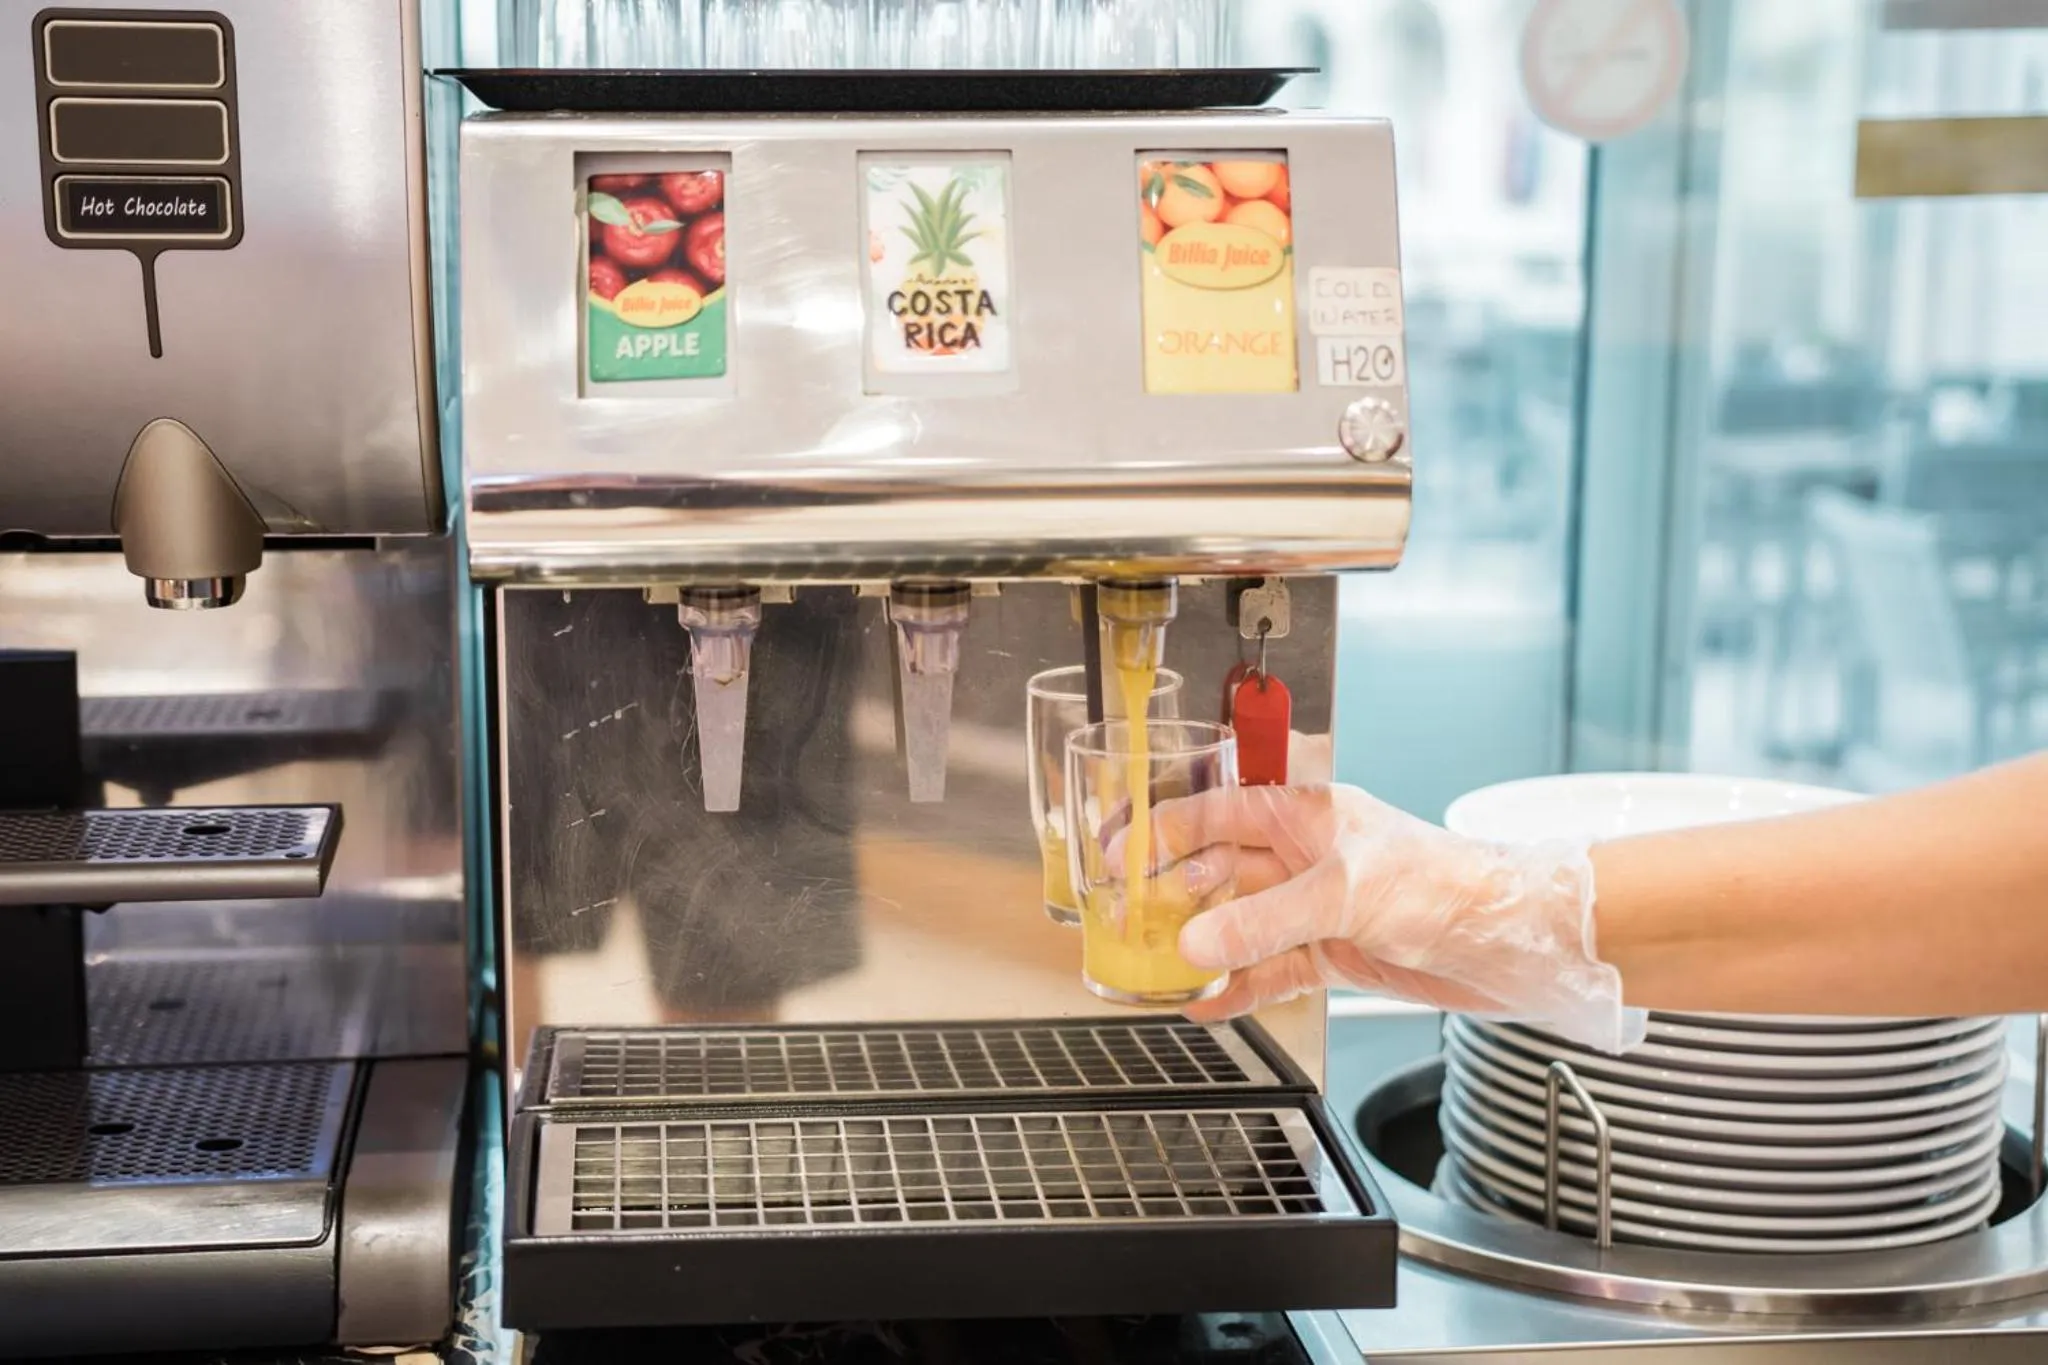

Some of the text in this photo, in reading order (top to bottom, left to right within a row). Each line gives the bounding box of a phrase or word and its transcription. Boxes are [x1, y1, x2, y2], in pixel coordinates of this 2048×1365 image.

[80, 196, 208, 216] Hot Chocolate
[1314, 276, 1393, 299] COLD
[887, 289, 998, 317] COSTA
[1312, 304, 1400, 326] WATER
[615, 332, 700, 359] APPLE
[904, 321, 982, 349] RICA
[1158, 329, 1283, 356] ORANGE
